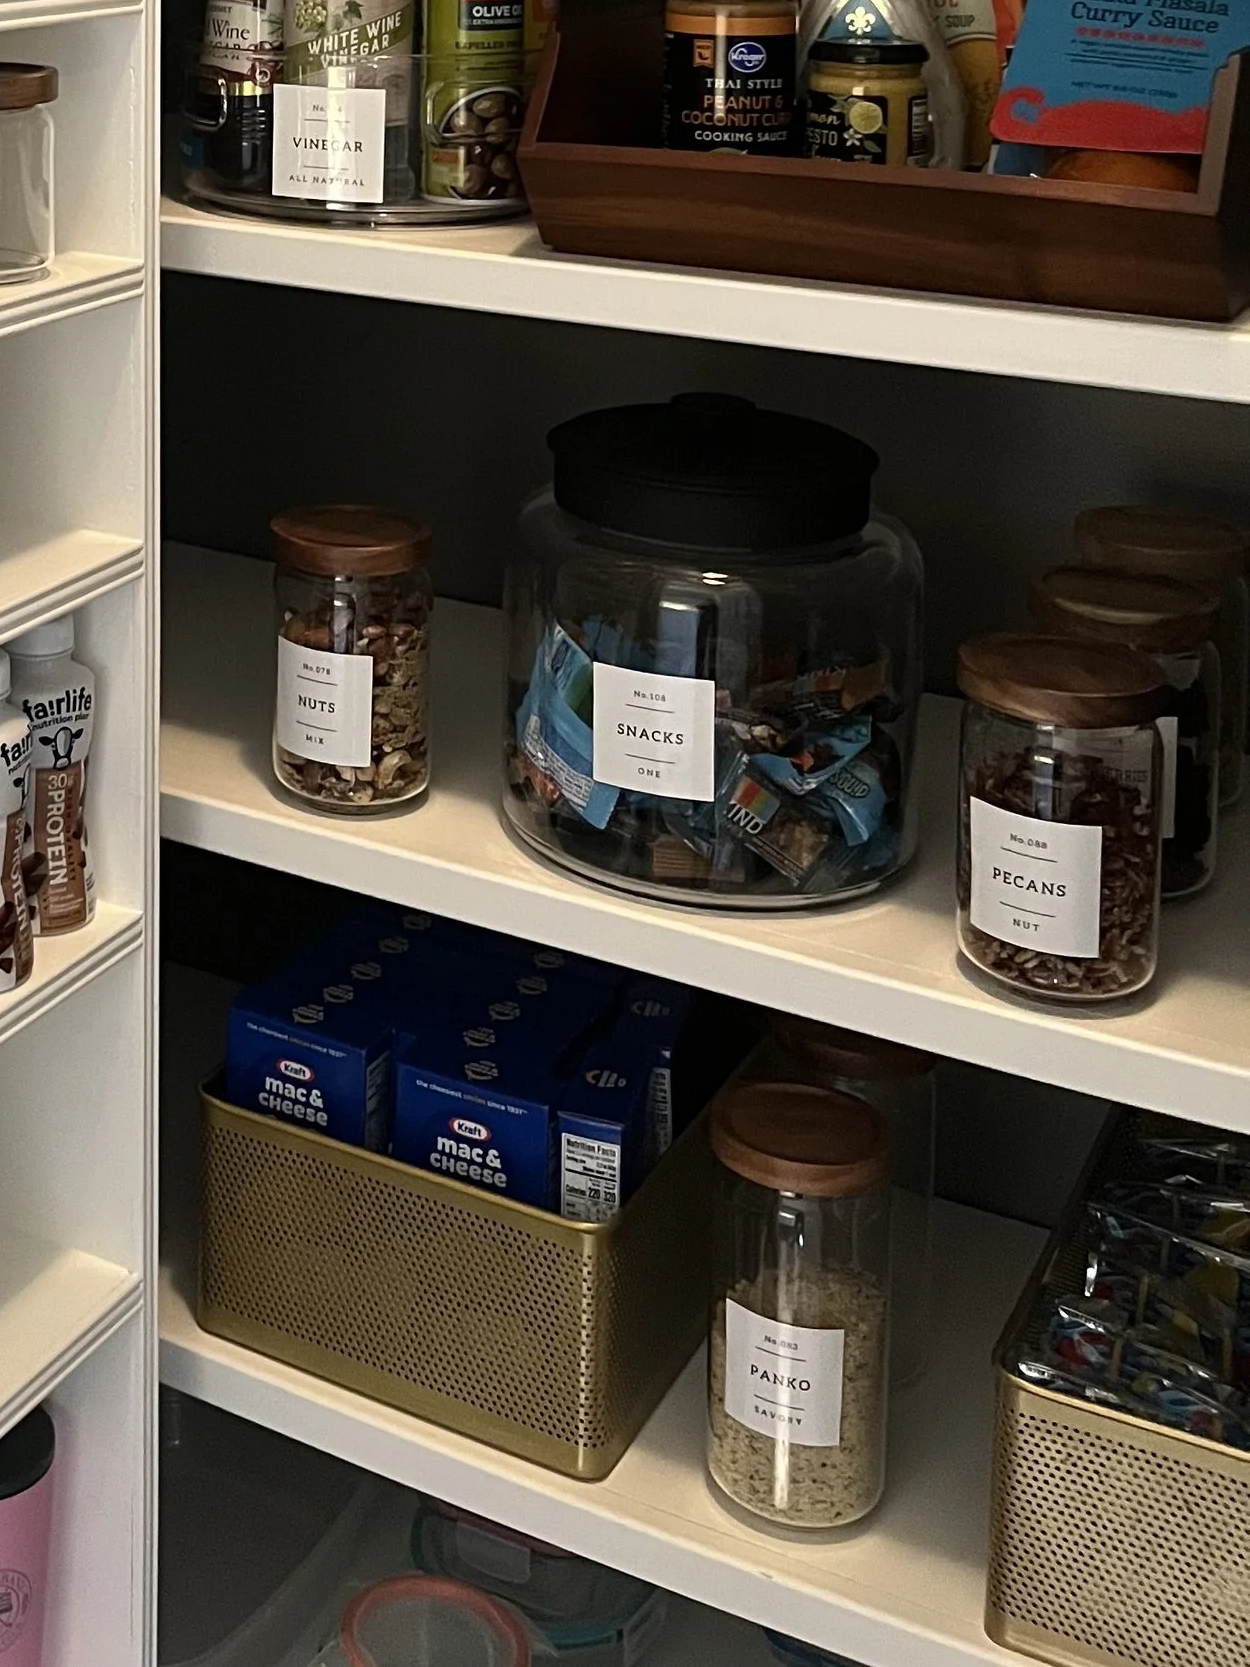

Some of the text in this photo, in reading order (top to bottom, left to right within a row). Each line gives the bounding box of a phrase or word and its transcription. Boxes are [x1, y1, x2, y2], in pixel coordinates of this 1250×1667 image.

[472, 5, 511, 17] OLIVE
[1071, 2, 1219, 34] Curry Sauce
[212, 18, 250, 40] Wine
[945, 15, 975, 28] SOUP
[307, 11, 402, 56] WHITE WINE
[321, 34, 390, 68] VINEGAR
[731, 47, 764, 67] Kroger
[705, 78, 782, 90] THAI STYLE
[703, 94, 783, 109] PEANUT &
[682, 111, 760, 126] COCONUT
[292, 136, 363, 153] VINEGAR
[695, 131, 788, 143] COOKING SAUCE
[289, 174, 308, 183] ALL
[298, 694, 336, 713] NUTS
[633, 689, 666, 703] No.108
[31, 715, 74, 732] nutrition
[306, 734, 324, 744] MIX
[617, 723, 684, 746] SNACKS
[637, 767, 661, 779] ONE
[46, 788, 68, 886] PROTEIN
[992, 866, 1067, 898] PECANS
[1012, 918, 1041, 932] NUT
[283, 1062, 307, 1078] Kraft
[265, 1075, 325, 1109] mac &
[457, 1122, 484, 1138] Kraft
[437, 1135, 502, 1169] mac &
[566, 1138, 596, 1153] Nutrition
[565, 1183, 616, 1204] Calories 220 320
[750, 1364, 811, 1392] PANKO
[754, 1405, 802, 1426] SAVORY
